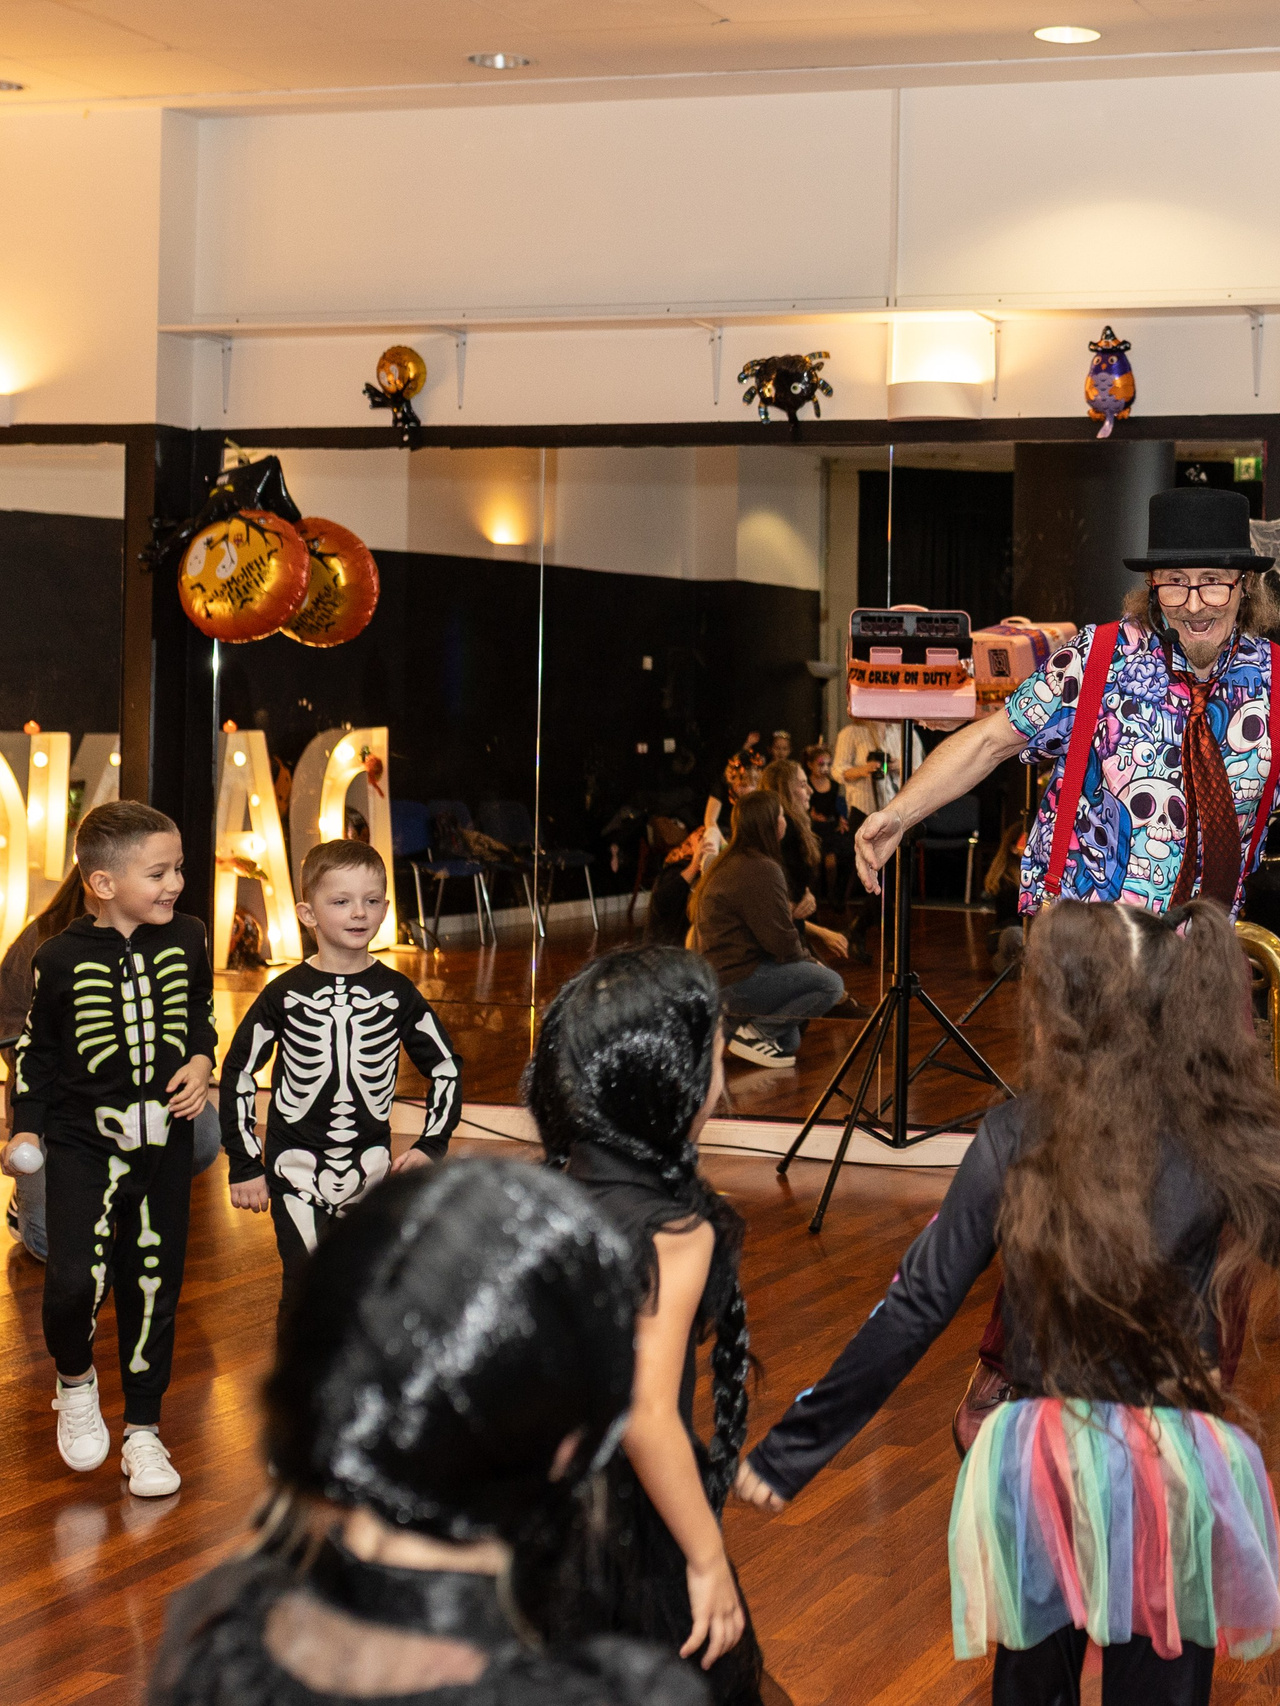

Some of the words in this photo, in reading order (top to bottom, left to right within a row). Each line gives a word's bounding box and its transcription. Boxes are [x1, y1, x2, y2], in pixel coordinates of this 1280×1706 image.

[868, 670, 900, 686] CREW
[904, 671, 919, 686] ON
[923, 671, 952, 687] DUTY
